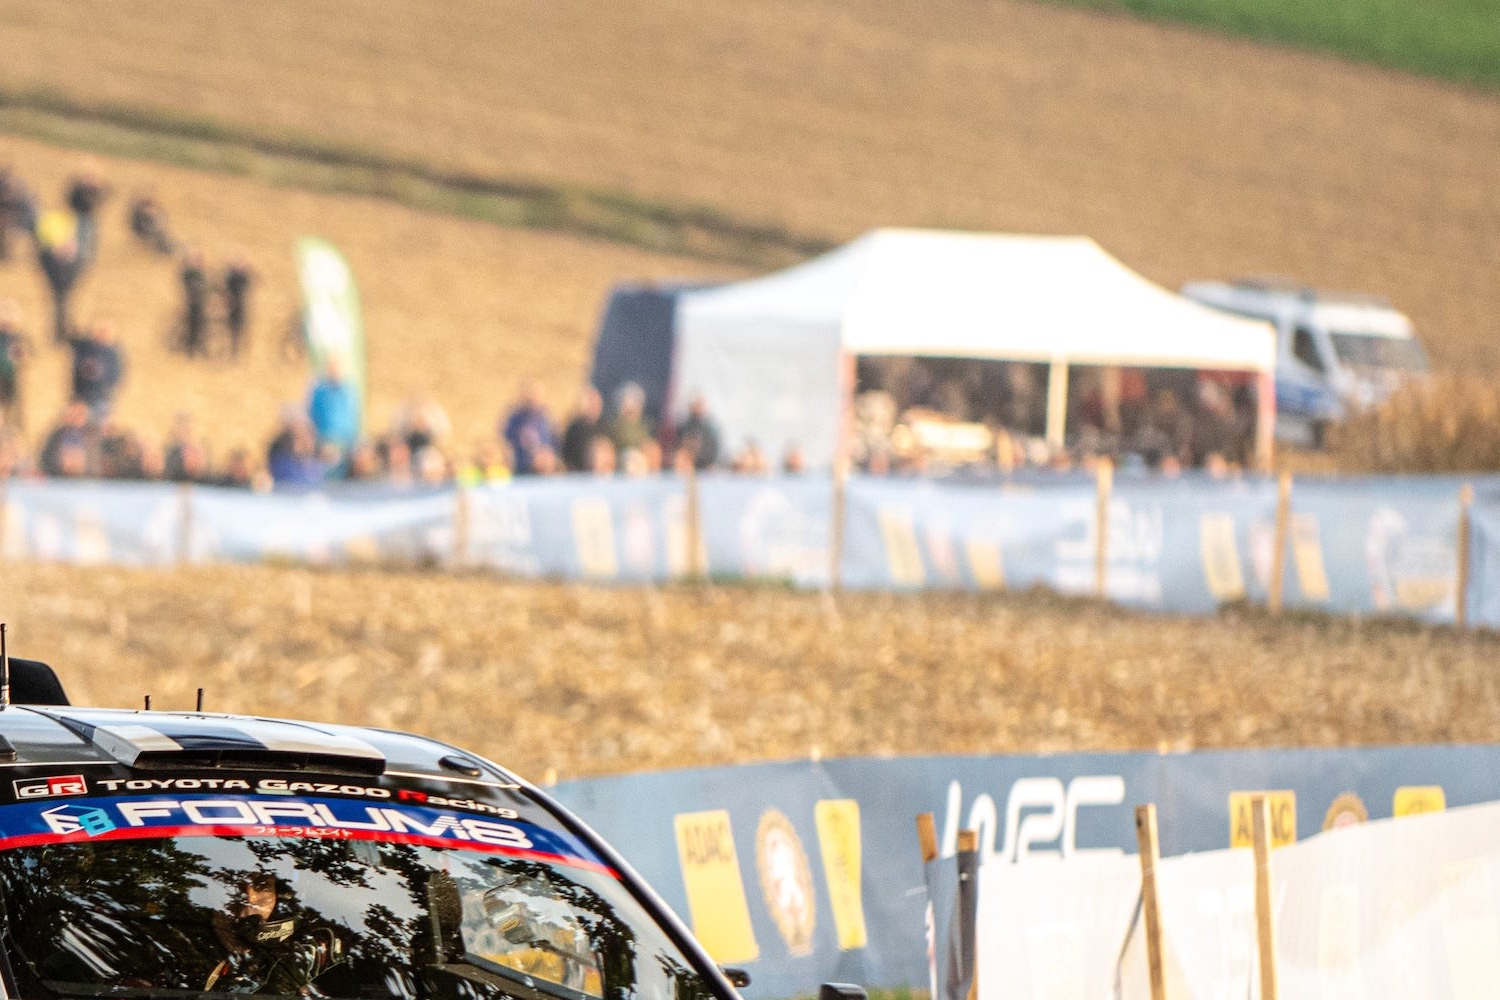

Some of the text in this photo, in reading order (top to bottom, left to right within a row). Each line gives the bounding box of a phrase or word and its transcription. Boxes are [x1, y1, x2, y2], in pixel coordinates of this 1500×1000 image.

[19, 784, 83, 798] GR
[96, 779, 520, 820] TOYOTA GAZOO Racing
[115, 799, 534, 850] FORUM8
[1237, 803, 1293, 841] AAC
